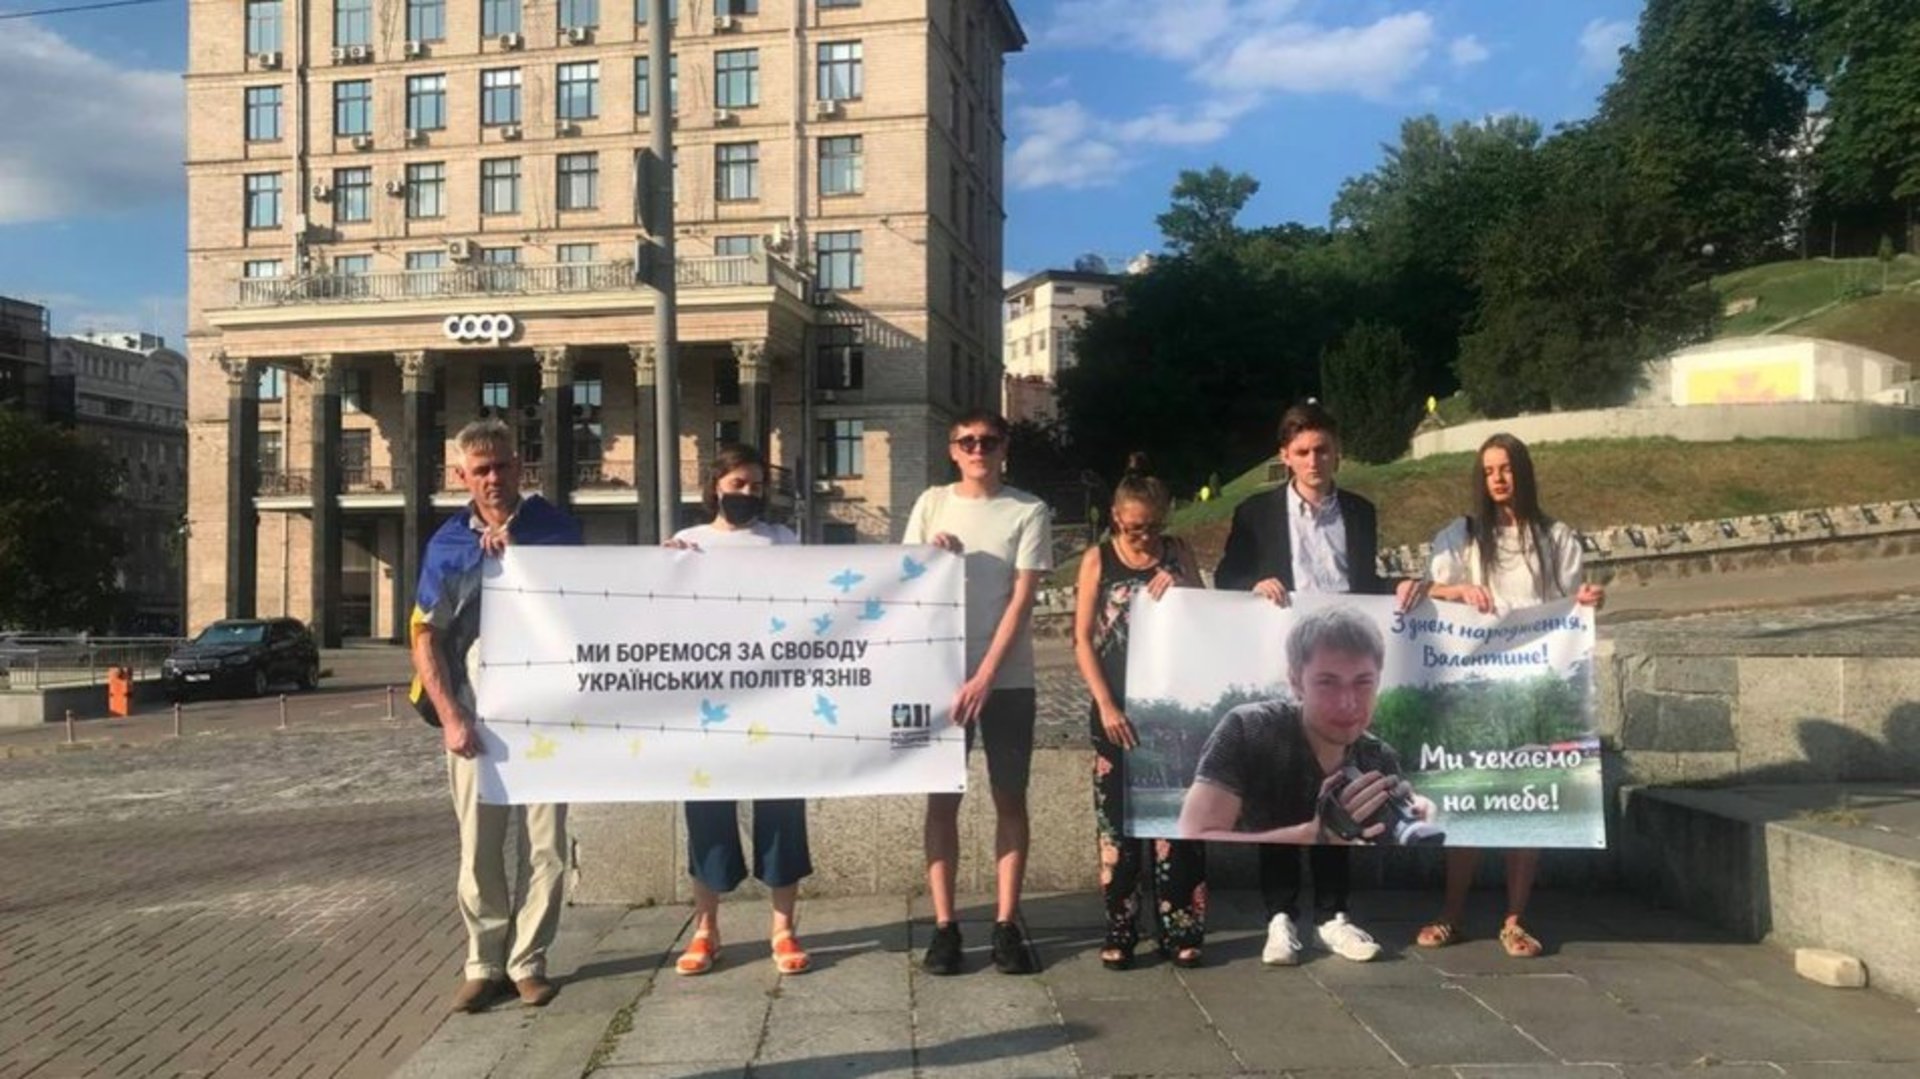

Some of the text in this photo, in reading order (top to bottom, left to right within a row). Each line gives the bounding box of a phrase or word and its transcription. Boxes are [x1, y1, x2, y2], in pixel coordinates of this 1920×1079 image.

[1406, 616, 1454, 640] днем
[1459, 613, 1588, 644] народження,
[576, 639, 869, 664] МИ БОРЕМОСЯ ЗА СВОБОДУ
[1422, 643, 1549, 669] Валентине!
[577, 667, 724, 693] УКРАЇНСЬКИХ
[1420, 742, 1582, 771] Ми чекаємо
[1443, 783, 1559, 812] на тебе!
